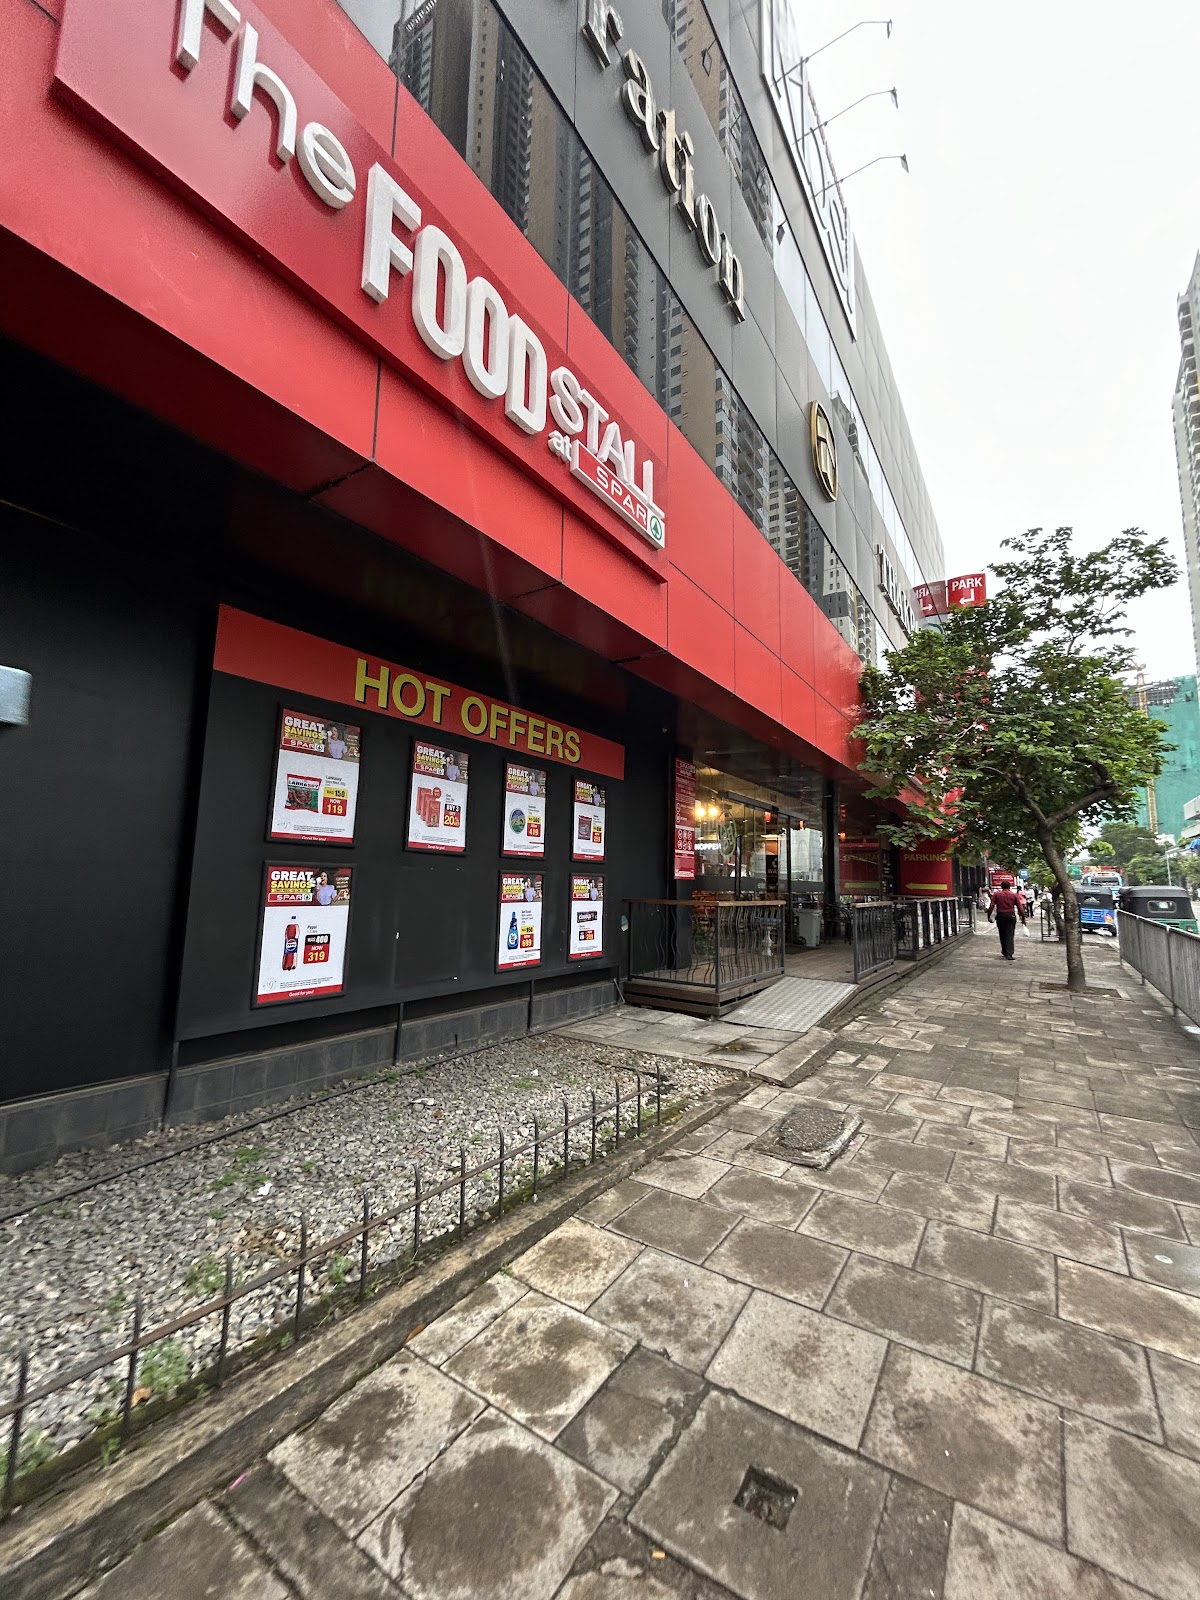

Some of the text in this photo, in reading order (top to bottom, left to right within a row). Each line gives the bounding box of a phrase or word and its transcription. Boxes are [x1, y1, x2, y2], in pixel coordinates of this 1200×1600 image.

[177, 0, 356, 208] The
[361, 162, 547, 434] FOOD
[549, 366, 666, 520] STALL
[548, 430, 648, 527] at SPAR
[952, 577, 983, 592] PARK
[355, 658, 582, 763] HOT OFFERS
[284, 716, 325, 733] GREAT
[284, 725, 325, 740] SAVINGS
[290, 739, 316, 750] SPAR
[417, 745, 446, 759] GREAT
[416, 753, 444, 765] SAVINGS
[508, 767, 528, 778] GREAT
[335, 790, 345, 798] 150
[326, 804, 343, 814] 119
[903, 853, 948, 862] PARKING
[270, 870, 313, 881] GREAT
[502, 877, 524, 885] GREAT
[270, 881, 313, 889] SAVINGS
[316, 935, 328, 944] 400
[308, 951, 325, 962] 319
